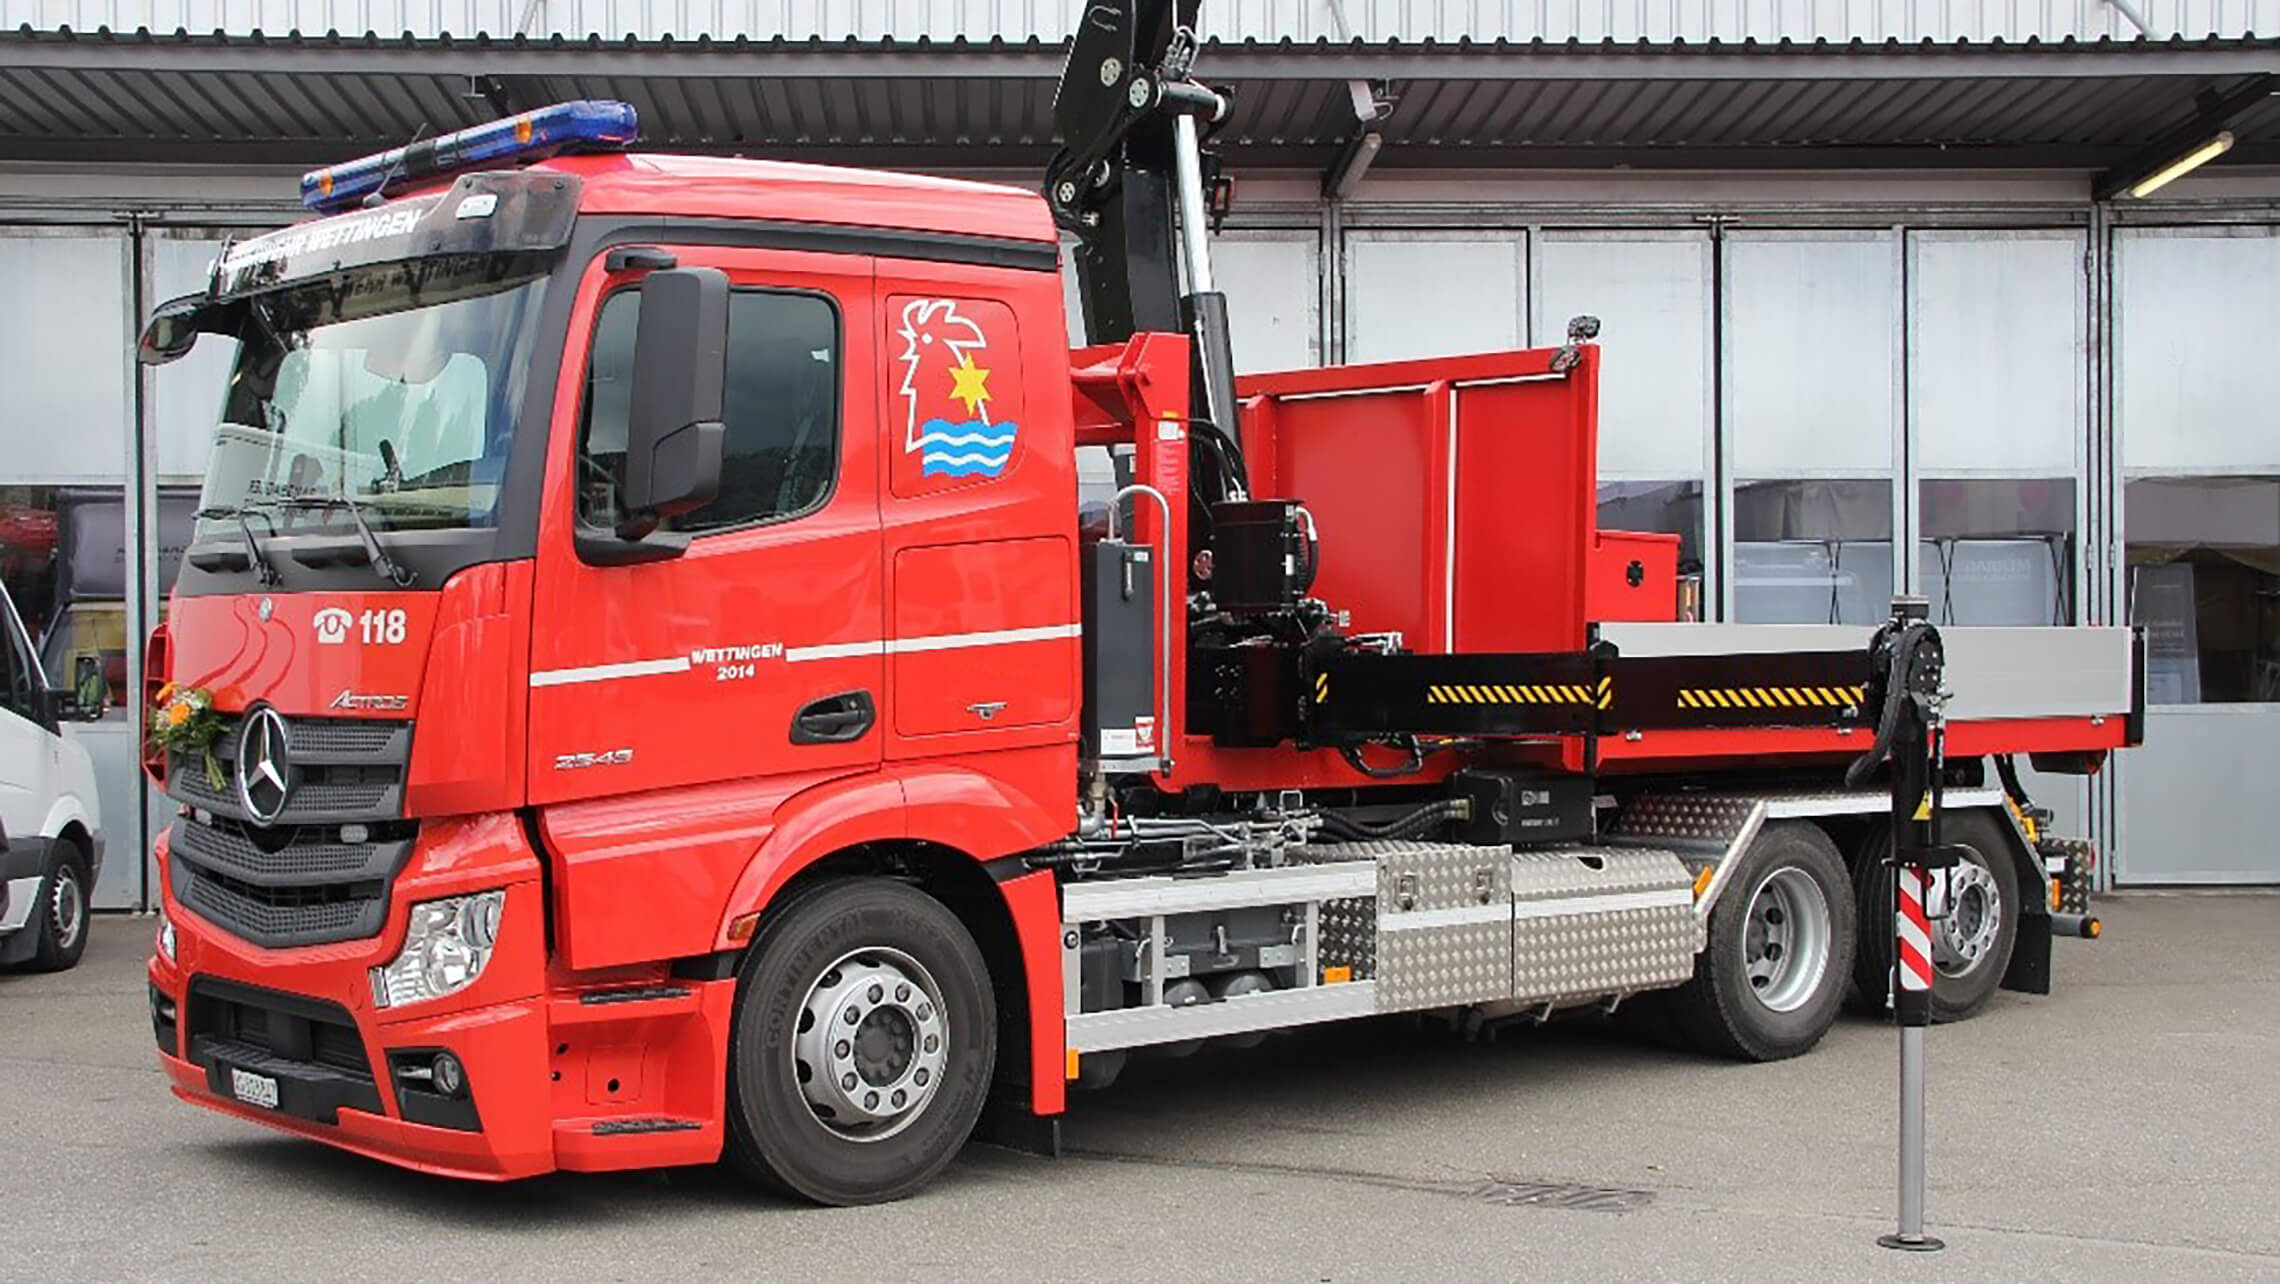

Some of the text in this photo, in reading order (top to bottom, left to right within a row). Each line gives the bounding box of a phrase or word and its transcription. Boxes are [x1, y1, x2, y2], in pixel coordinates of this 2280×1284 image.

[306, 208, 423, 252] WETTINGEN
[360, 609, 406, 644] 118
[691, 642, 784, 665] WETTINGEN
[717, 664, 756, 682] 2014
